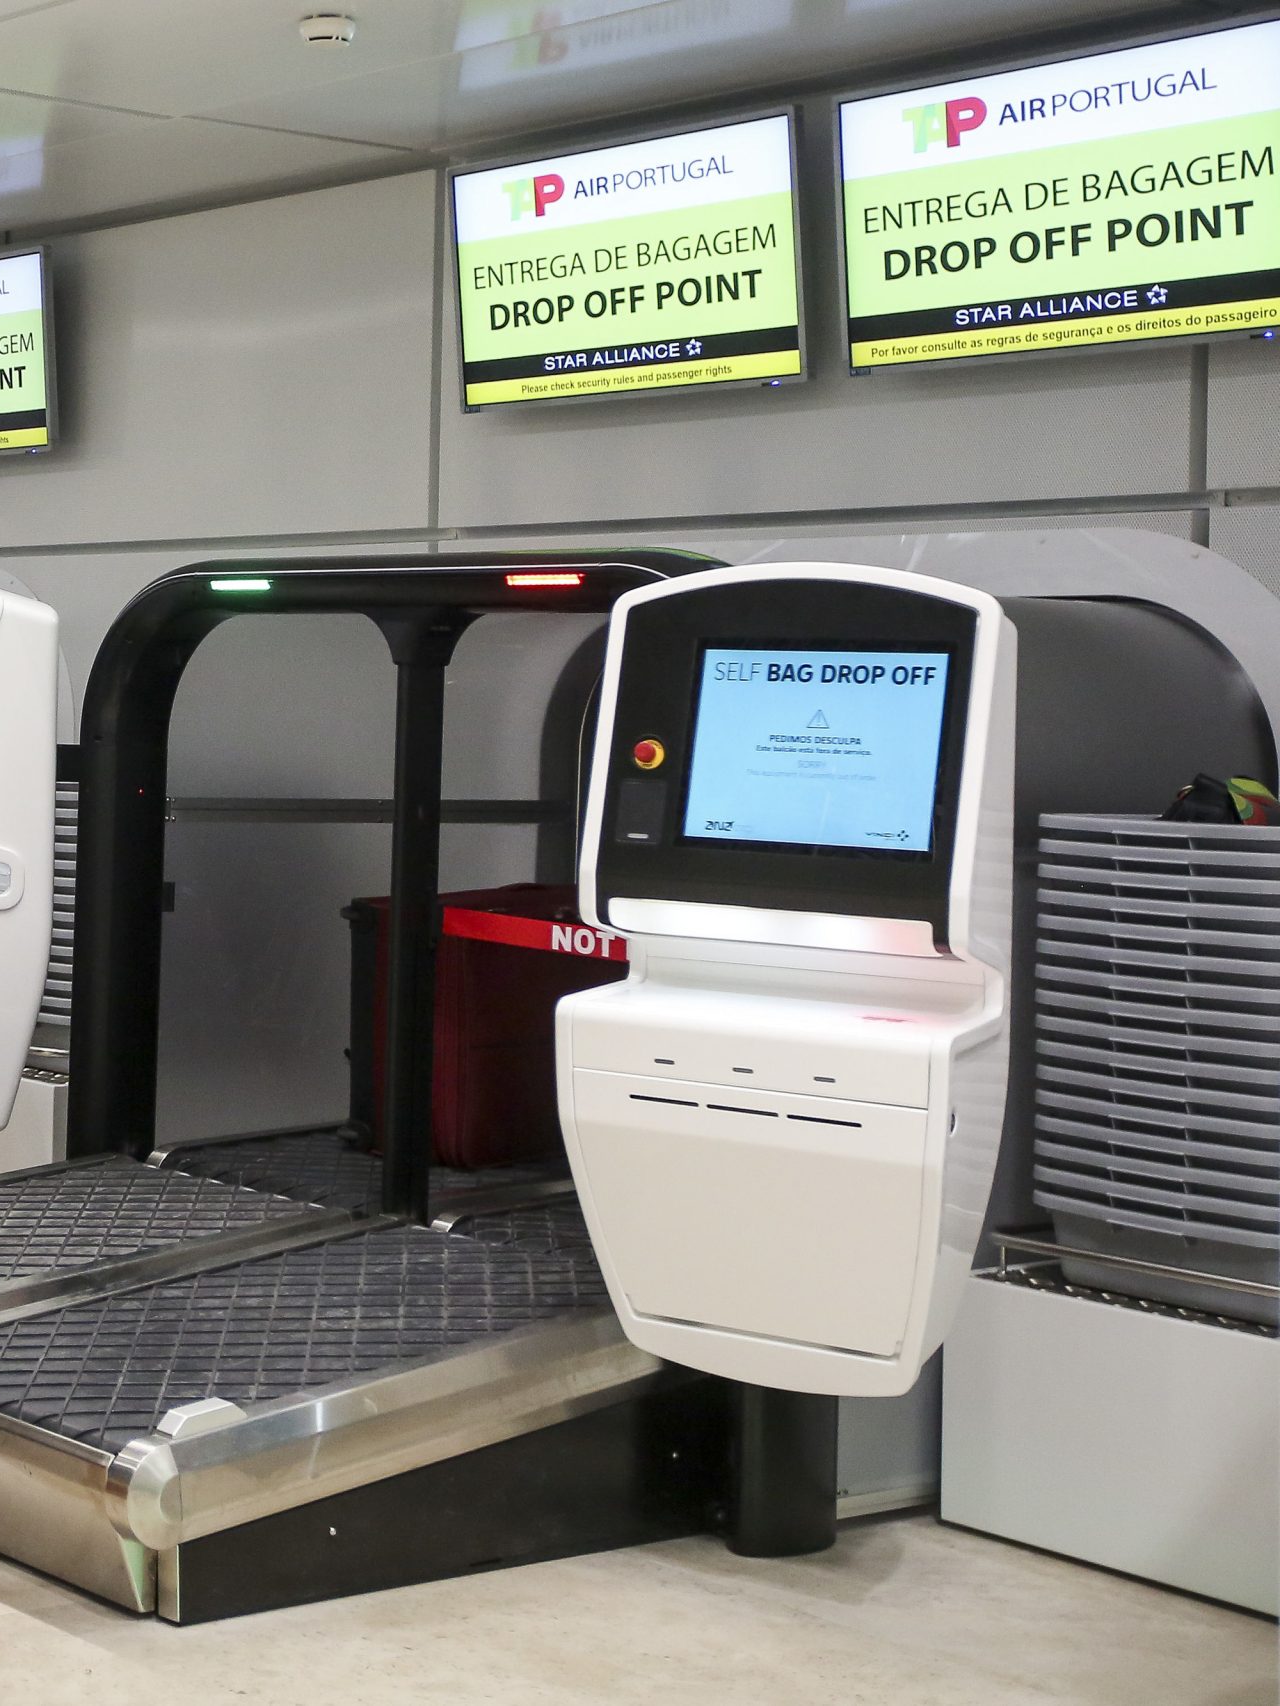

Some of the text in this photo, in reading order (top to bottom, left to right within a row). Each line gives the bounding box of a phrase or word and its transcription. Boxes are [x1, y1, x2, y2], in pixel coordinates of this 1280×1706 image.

[902, 96, 987, 153] TAP
[502, 173, 565, 221] TAP
[864, 146, 1275, 234] ENTREGA DE BAGAGEM
[474, 224, 777, 290] ENTREGA DE BAGAGEM
[884, 201, 1253, 281] DROP OFF POINT
[489, 269, 762, 331] DROP OFF POINT
[955, 290, 1138, 326] STAR ALLIANCE
[544, 342, 680, 371] STAR ALLIANCE
[871, 307, 1277, 358] Por favor consulte as regras de segurança e os direitos do passageiro
[521, 364, 732, 394] Please check security rules and passenger rights
[714, 662, 937, 686] SELF BAG DROP OFF
[769, 734, 861, 745] PEDIMOS DESCULPA
[551, 925, 615, 957] NOT
